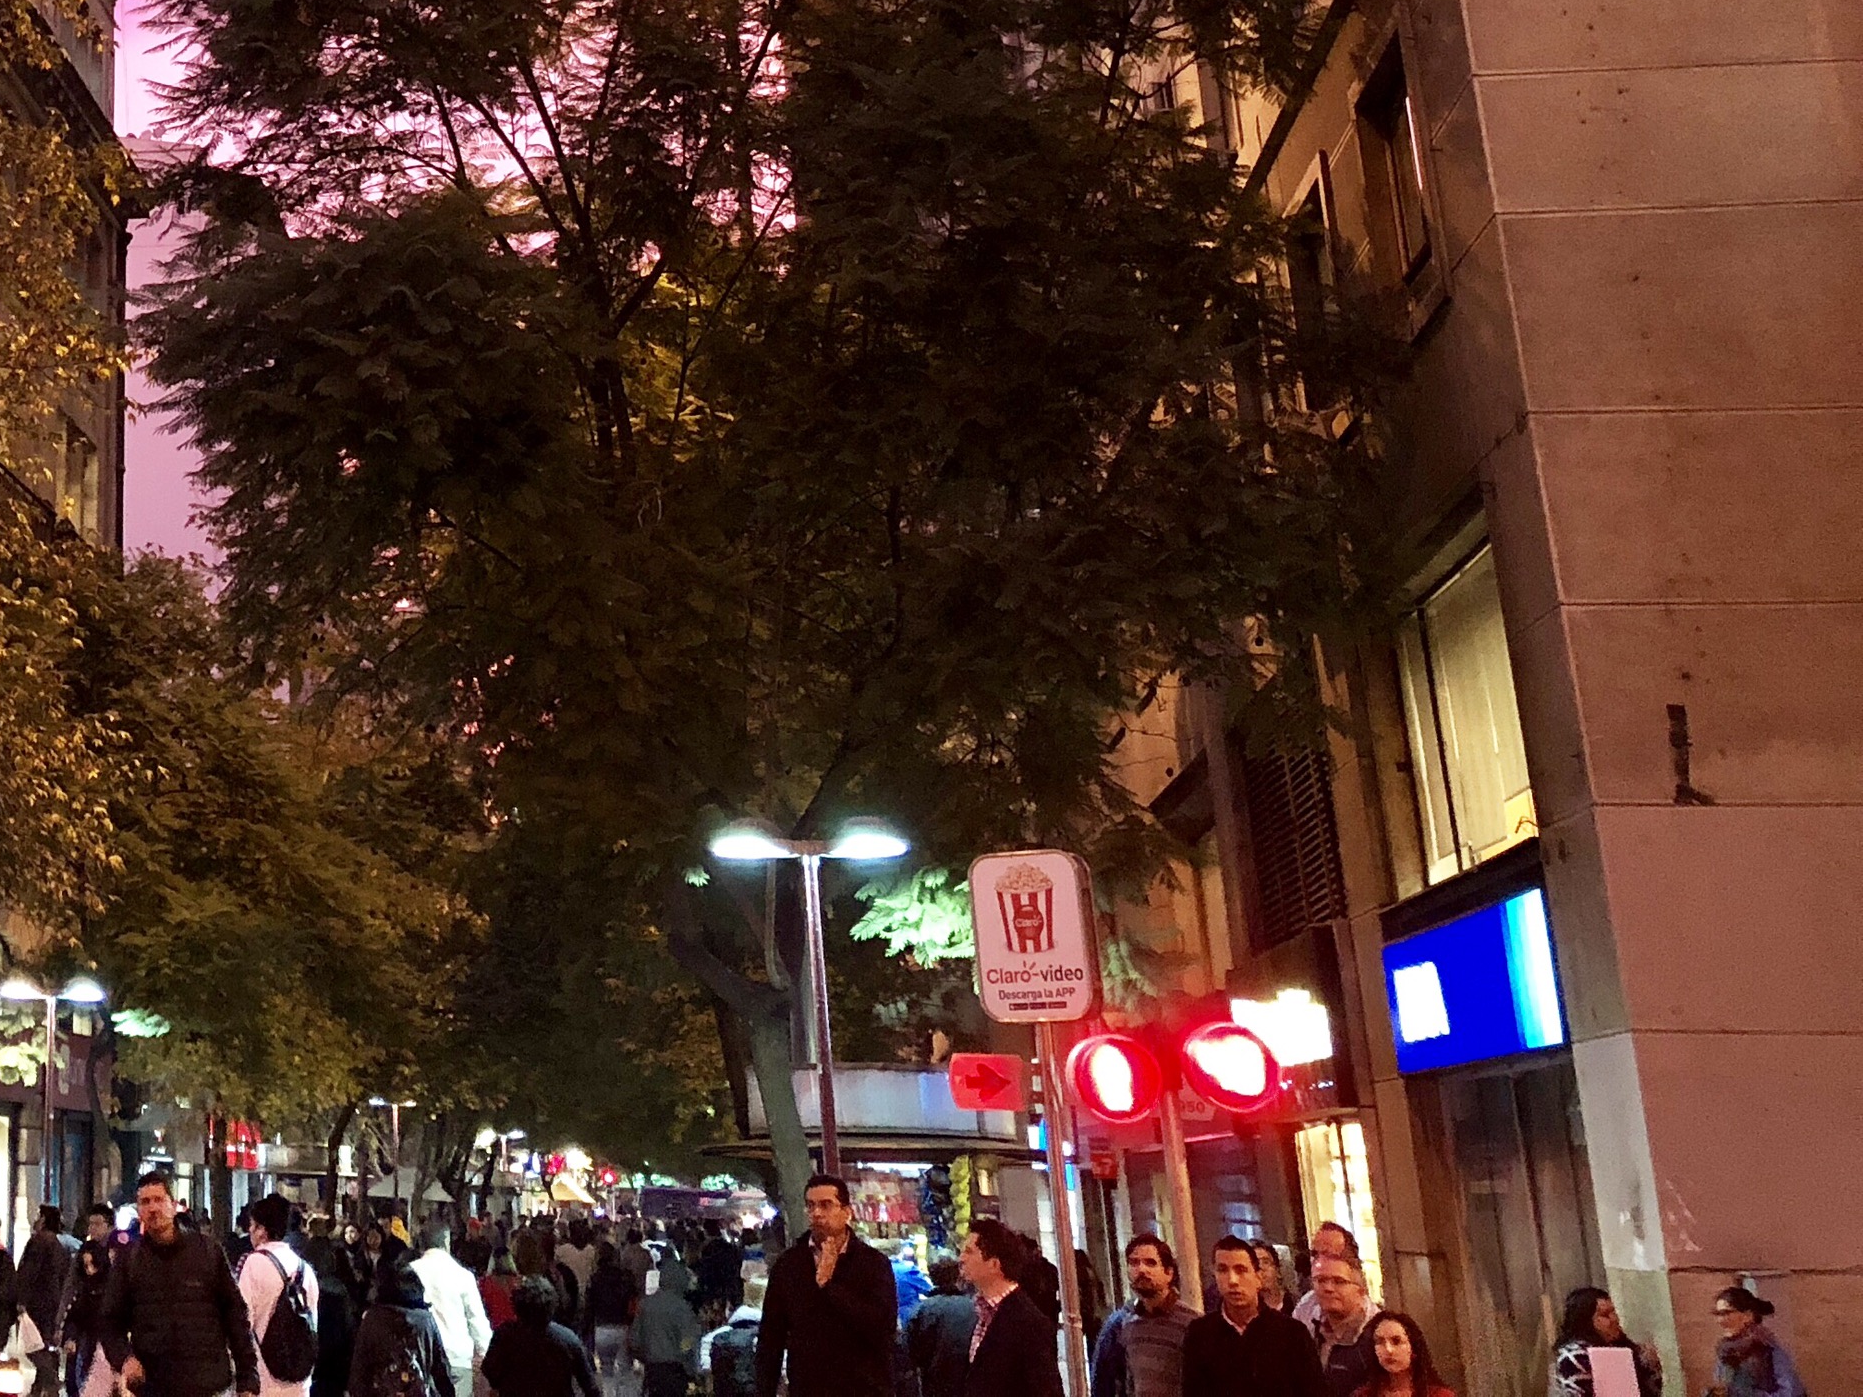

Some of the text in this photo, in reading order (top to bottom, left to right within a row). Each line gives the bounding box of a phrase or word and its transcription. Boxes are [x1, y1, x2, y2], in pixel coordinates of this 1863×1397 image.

[987, 964, 1084, 984] Claro video
[999, 987, 1076, 1001] Descarga la APP
